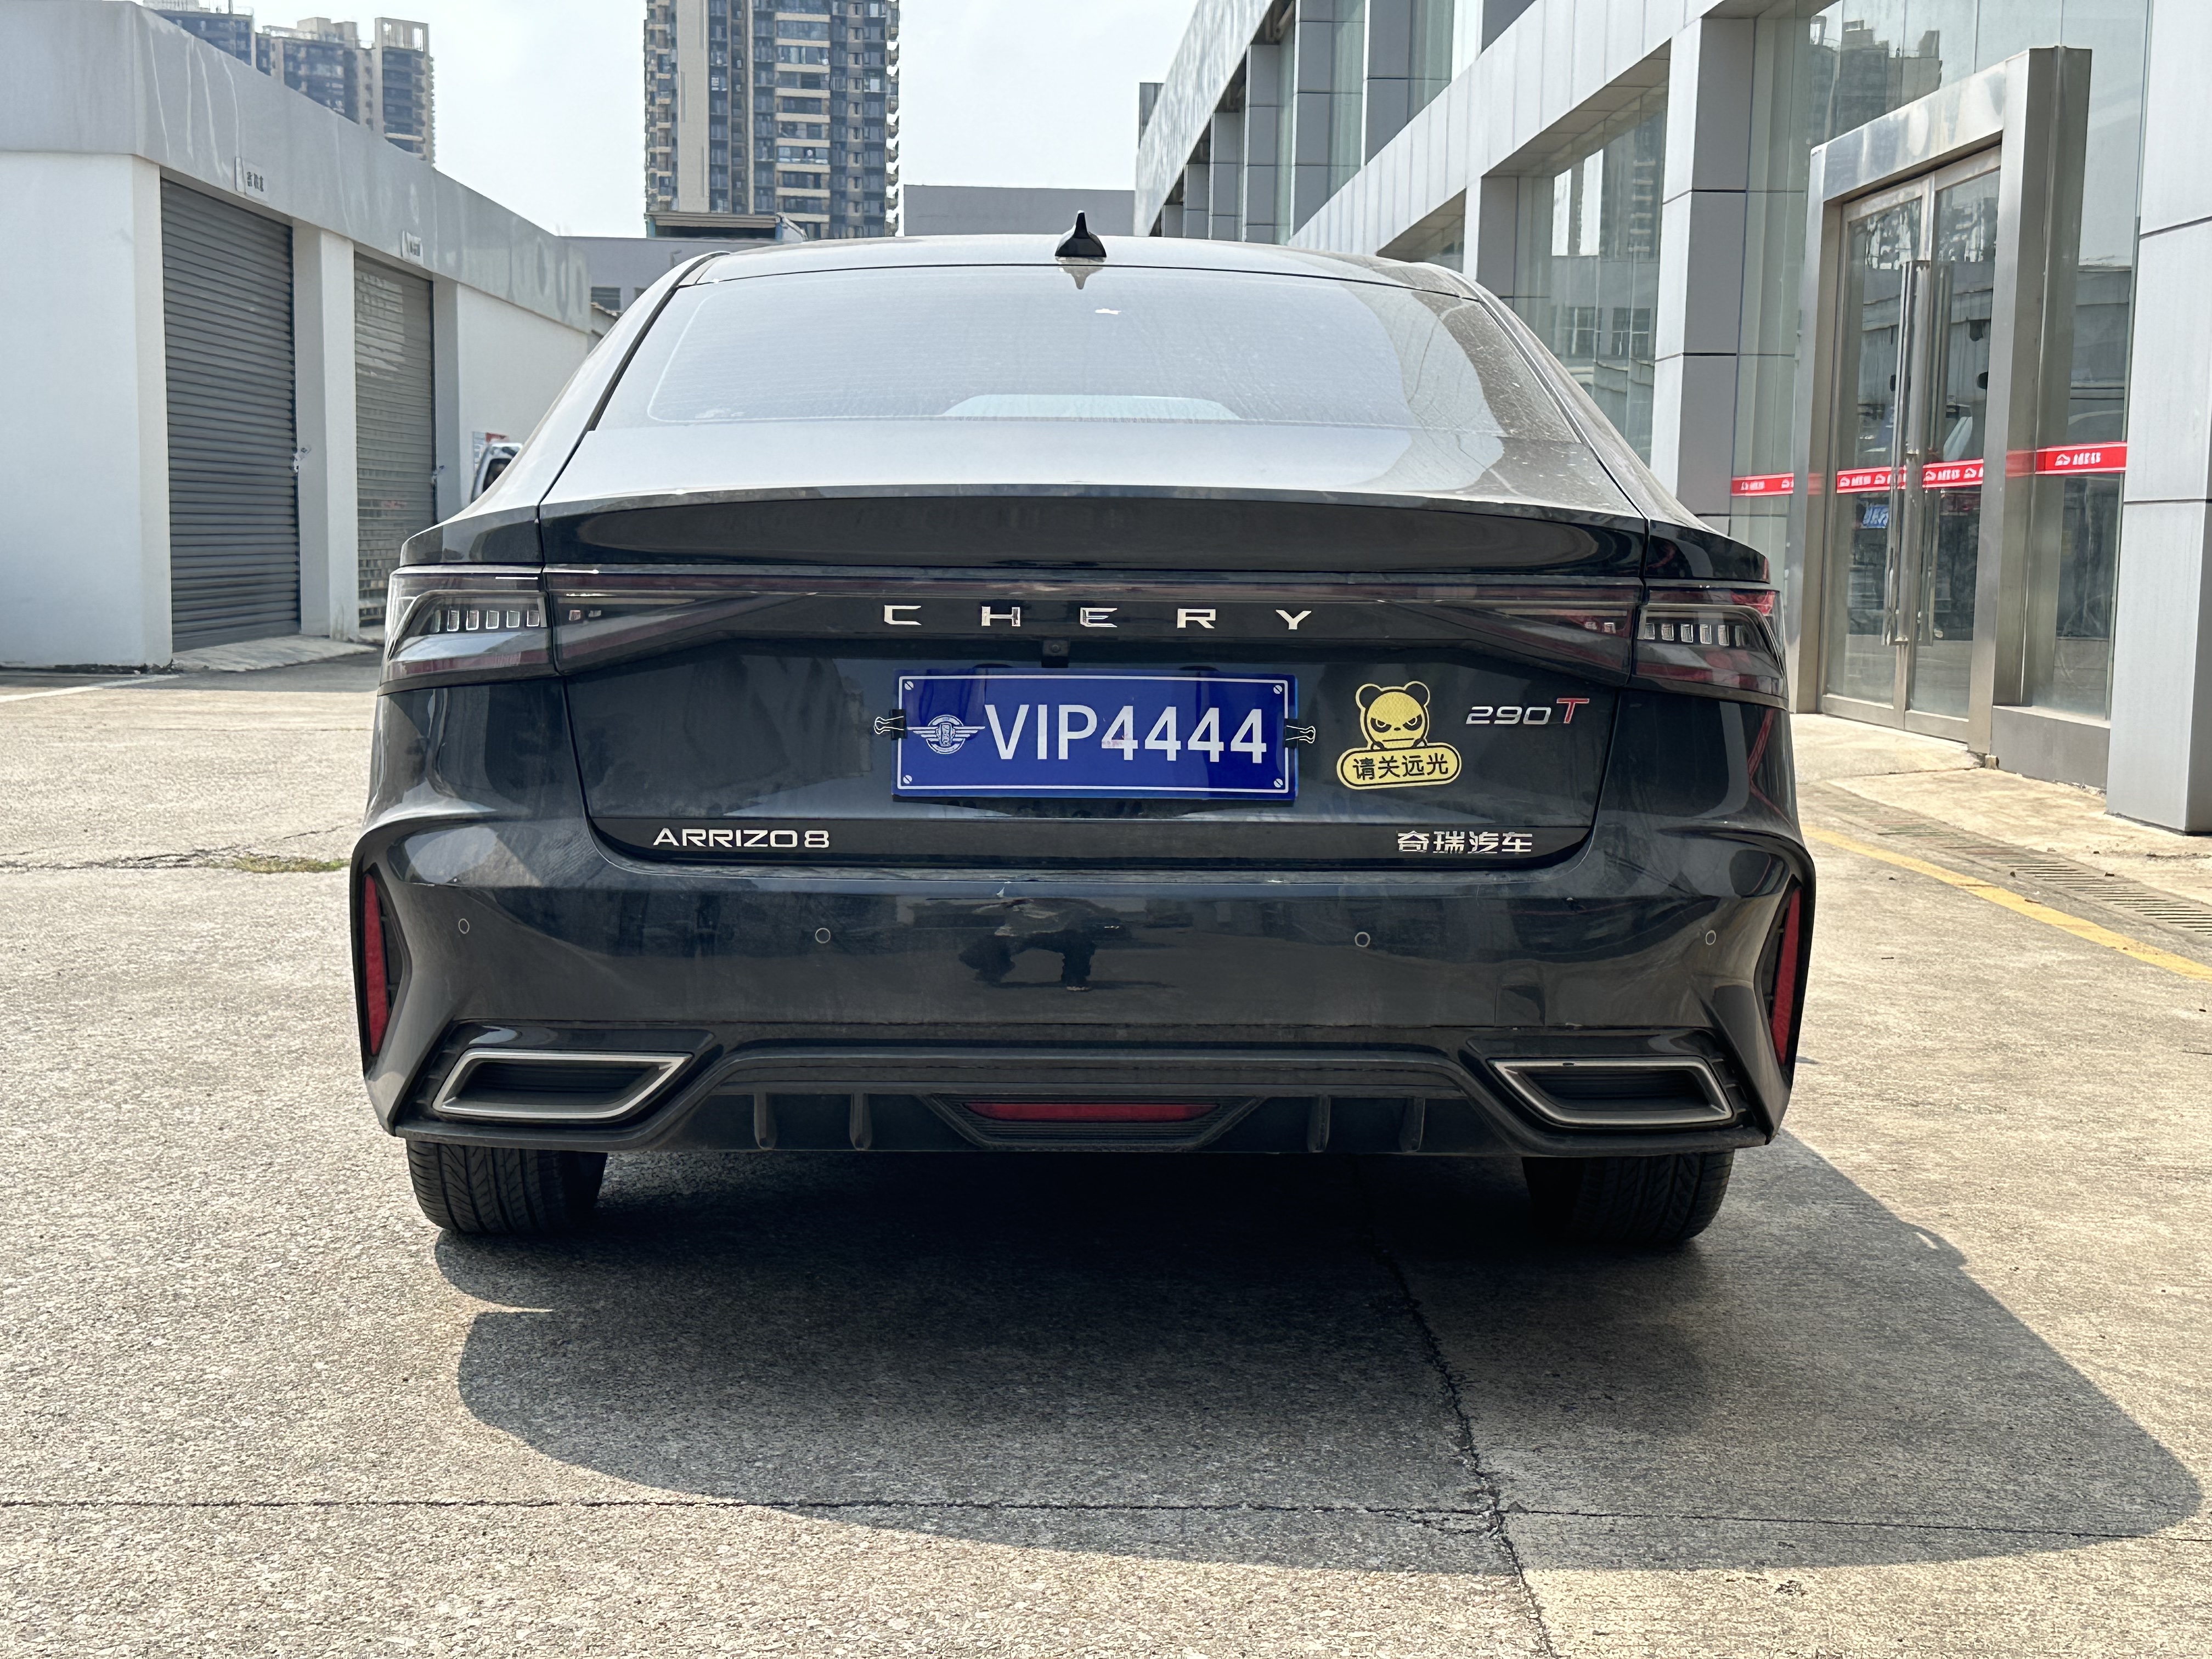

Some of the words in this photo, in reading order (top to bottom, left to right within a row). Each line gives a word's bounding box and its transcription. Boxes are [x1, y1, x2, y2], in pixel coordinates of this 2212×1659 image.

[884, 605, 1312, 630] CHERY
[1465, 697, 1590, 725] 290T
[985, 704, 1267, 764] VIP4444
[1352, 752, 1448, 780] 请关远光
[1397, 830, 1533, 854] 奇瑞汽车
